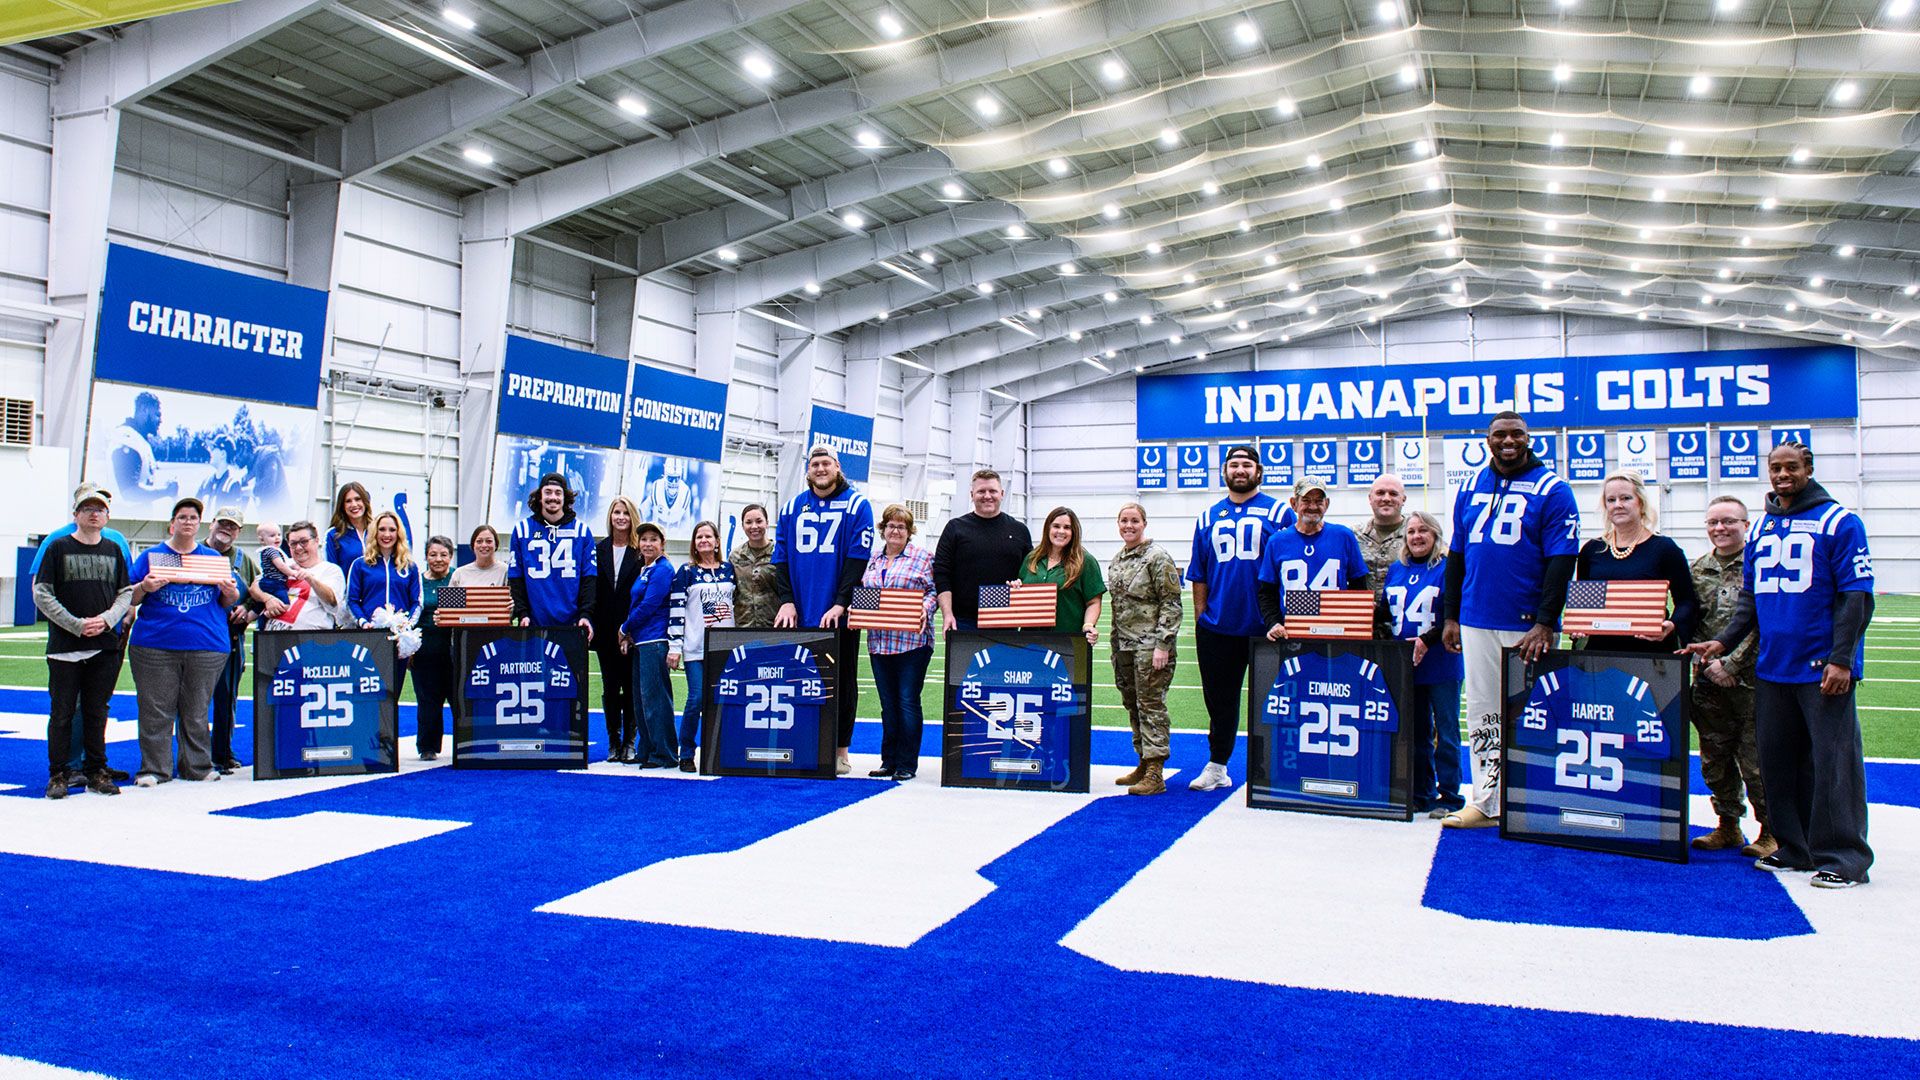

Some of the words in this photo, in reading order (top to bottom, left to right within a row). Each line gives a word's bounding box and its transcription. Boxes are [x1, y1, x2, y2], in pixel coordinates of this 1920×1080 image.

[128, 300, 303, 360] CHARACTER
[507, 373, 622, 414] PREPARATION
[1204, 372, 1565, 424] INDIANAPOLIS
[1596, 364, 1770, 411] COLTS
[633, 397, 723, 431] CONSISTENCY
[1729, 467, 1750, 475] 2013
[1469, 493, 1528, 546] 78
[796, 512, 842, 553] 67
[1212, 517, 1262, 563] 60
[64, 554, 117, 580] ARMY
[528, 539, 576, 578] 34
[1754, 532, 1815, 594] 29
[1280, 558, 1340, 598] 84
[472, 670, 489, 685] 25
[500, 662, 542, 675] PARTRIDGE
[551, 671, 570, 687] 25
[758, 667, 784, 679] WRIGHT
[1004, 671, 1032, 684] SHARP
[273, 680, 295, 696] 25
[360, 676, 380, 693] 25
[720, 679, 738, 695] 25
[802, 680, 821, 696] 25
[962, 682, 981, 698] 25
[1052, 684, 1072, 701] 25
[1309, 681, 1351, 698] EDWARDS
[300, 683, 353, 728] 25
[496, 682, 545, 725] 25
[745, 685, 795, 729] 25
[1267, 695, 1290, 715] 25
[1365, 700, 1389, 721] 25
[1572, 702, 1614, 721] HARPER
[987, 693, 1043, 741] 25
[1299, 701, 1360, 757] 25
[1523, 707, 1547, 731] 25
[1636, 720, 1663, 743] 25
[1555, 728, 1624, 793] 25
